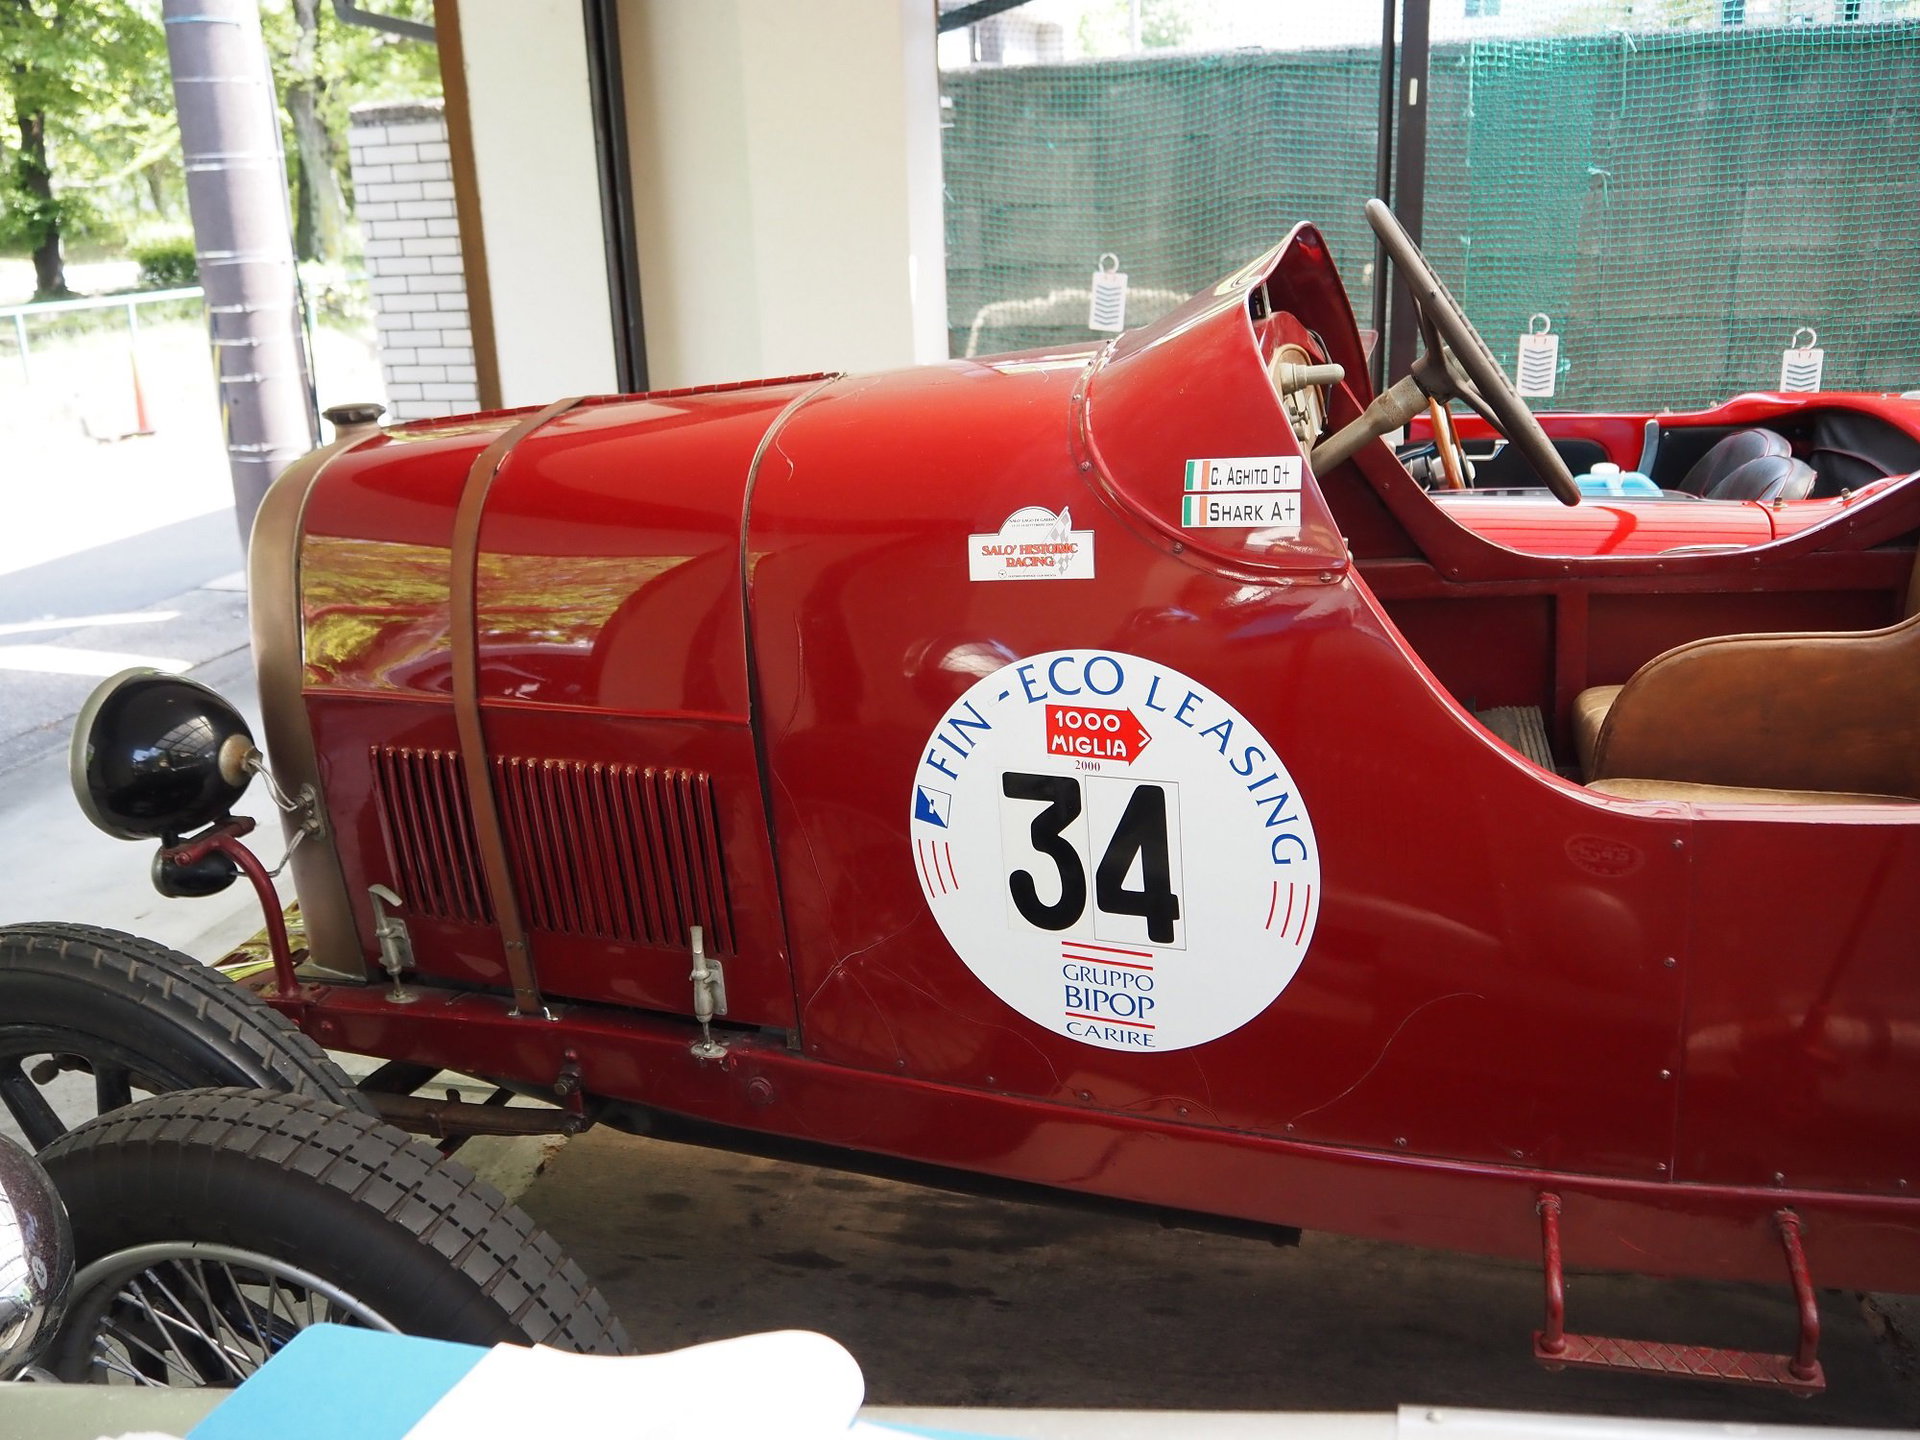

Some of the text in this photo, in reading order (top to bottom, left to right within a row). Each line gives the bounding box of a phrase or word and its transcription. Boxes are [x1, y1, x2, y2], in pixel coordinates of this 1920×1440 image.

[1211, 467, 1222, 485] C.
[1227, 467, 1268, 485] AGHITO
[1209, 498, 1296, 521] SHARK A+
[1020, 543, 1079, 555] HISTORIC
[1005, 555, 1055, 568] RACING
[1054, 710, 1121, 732] 1000
[1051, 734, 1127, 757] MIGLIA
[1074, 759, 1101, 772] 2000
[1145, 675, 1308, 866] LEASING
[1001, 770, 1181, 944] 34
[1062, 963, 1155, 993] GRUPPO
[1065, 985, 1156, 1019] BIPOP
[1065, 1021, 1157, 1049] CARIRE
